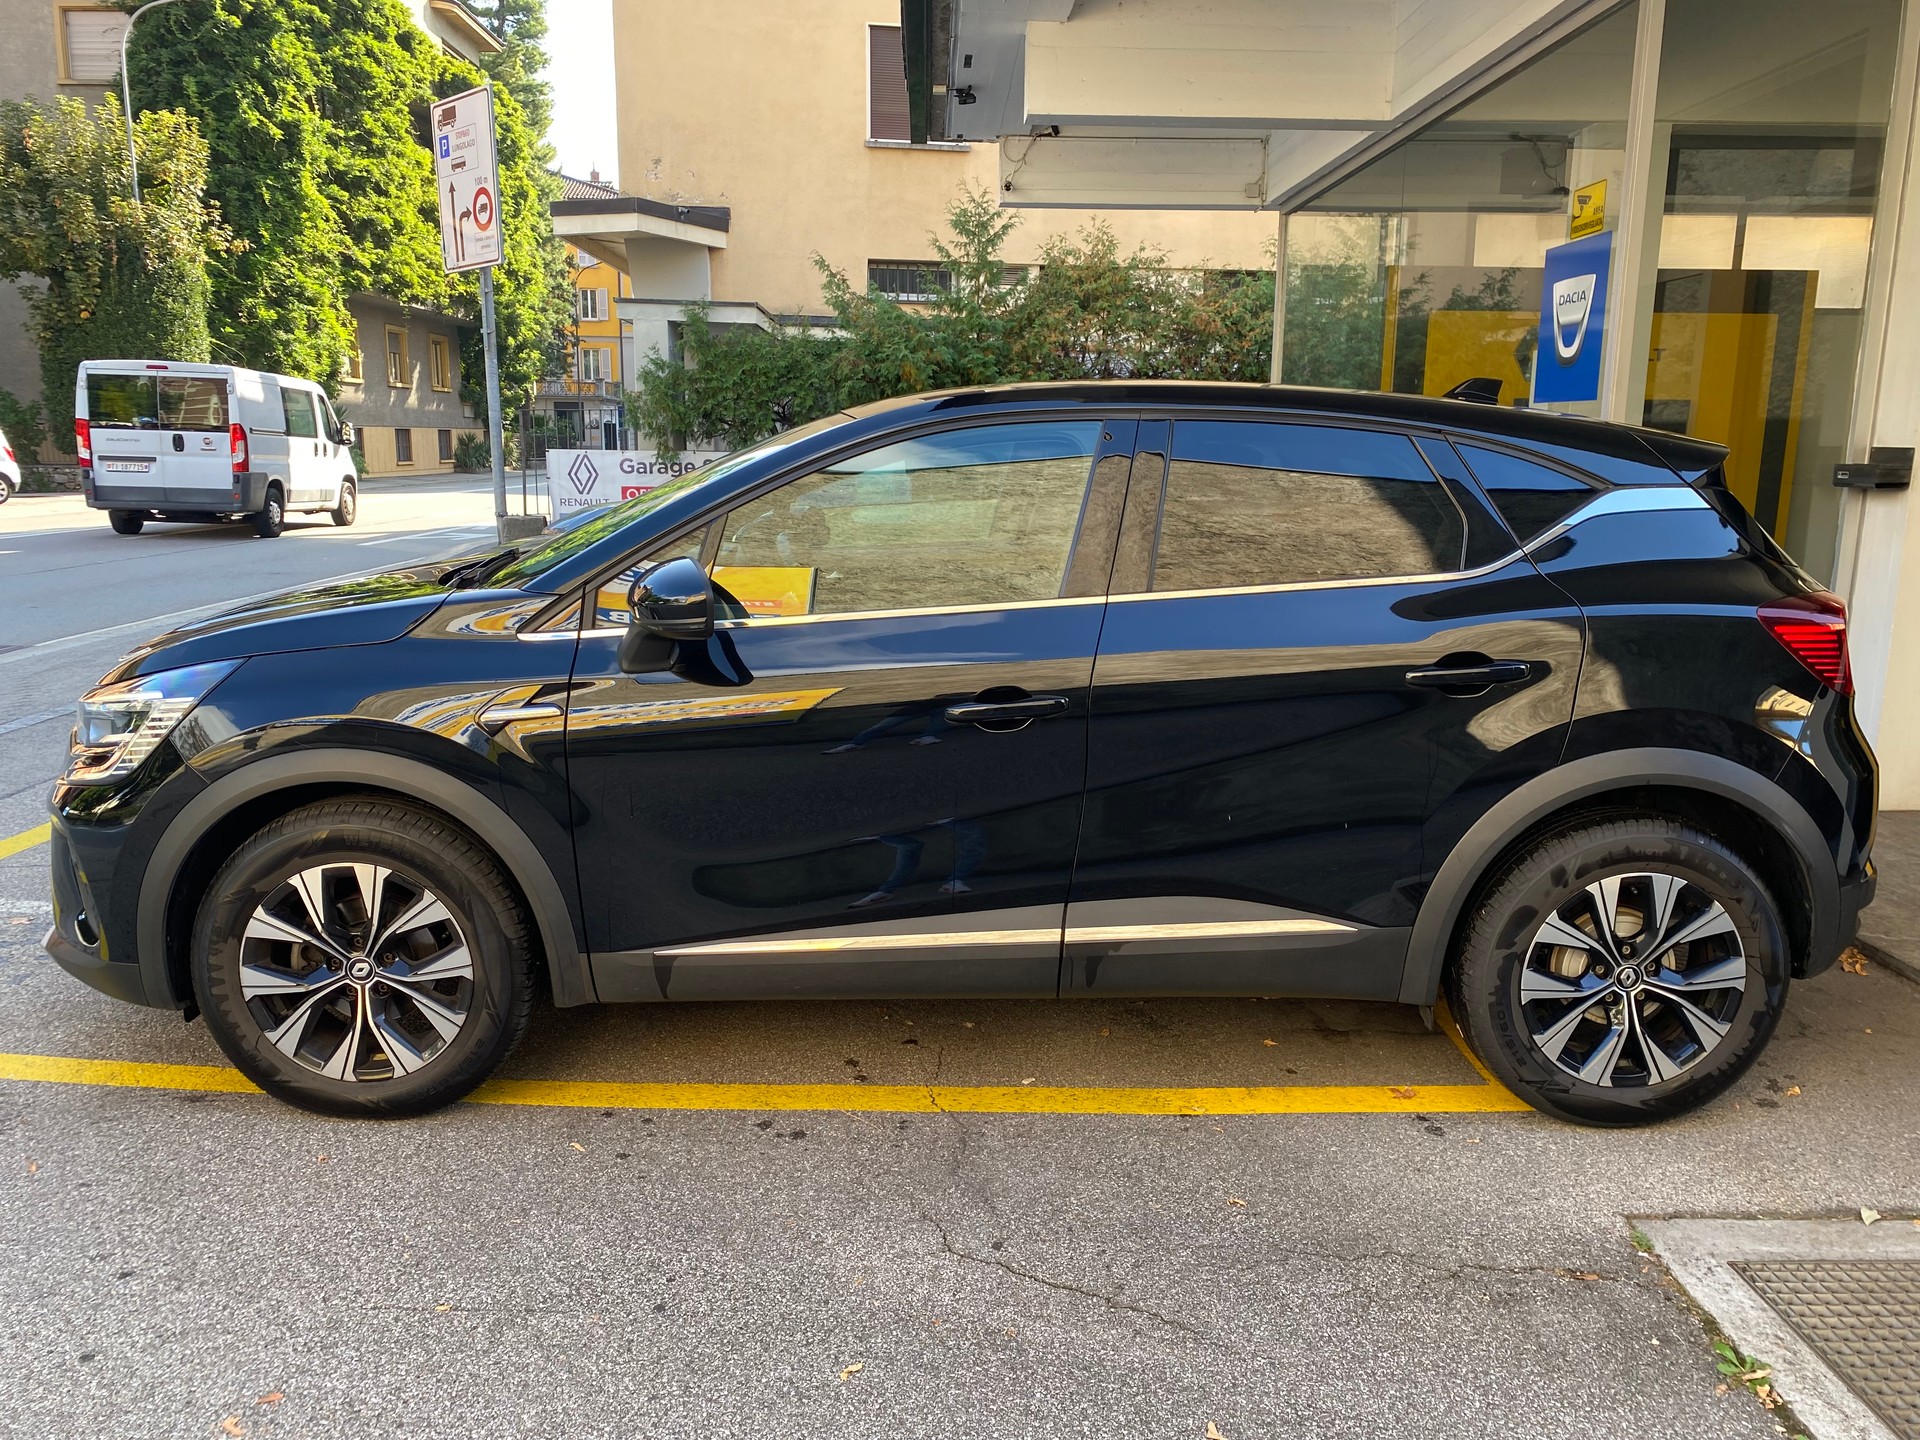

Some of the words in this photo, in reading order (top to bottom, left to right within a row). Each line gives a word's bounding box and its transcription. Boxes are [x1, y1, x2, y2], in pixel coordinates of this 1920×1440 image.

[452, 138, 475, 152] LUNGOLAGO
[474, 176, 483, 186] 100
[1559, 290, 1587, 306] DACIA
[619, 457, 696, 478] Garage
